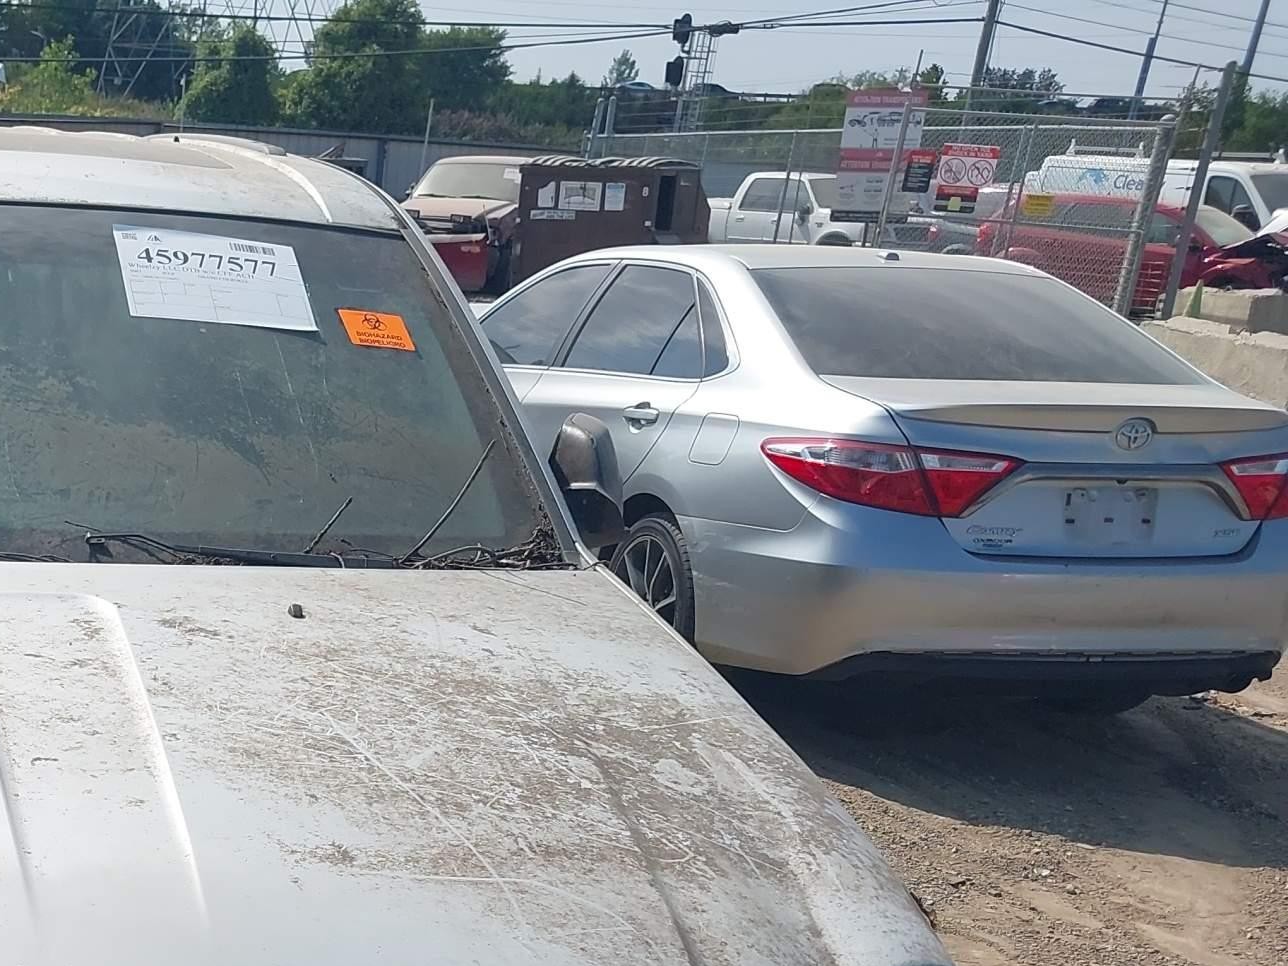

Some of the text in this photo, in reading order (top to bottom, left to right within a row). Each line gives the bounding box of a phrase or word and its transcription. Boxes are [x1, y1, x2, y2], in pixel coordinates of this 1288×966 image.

[1113, 174, 1144, 191] Clea
[137, 248, 276, 277] 45977577
[356, 330, 403, 341] BIOHAZARD
